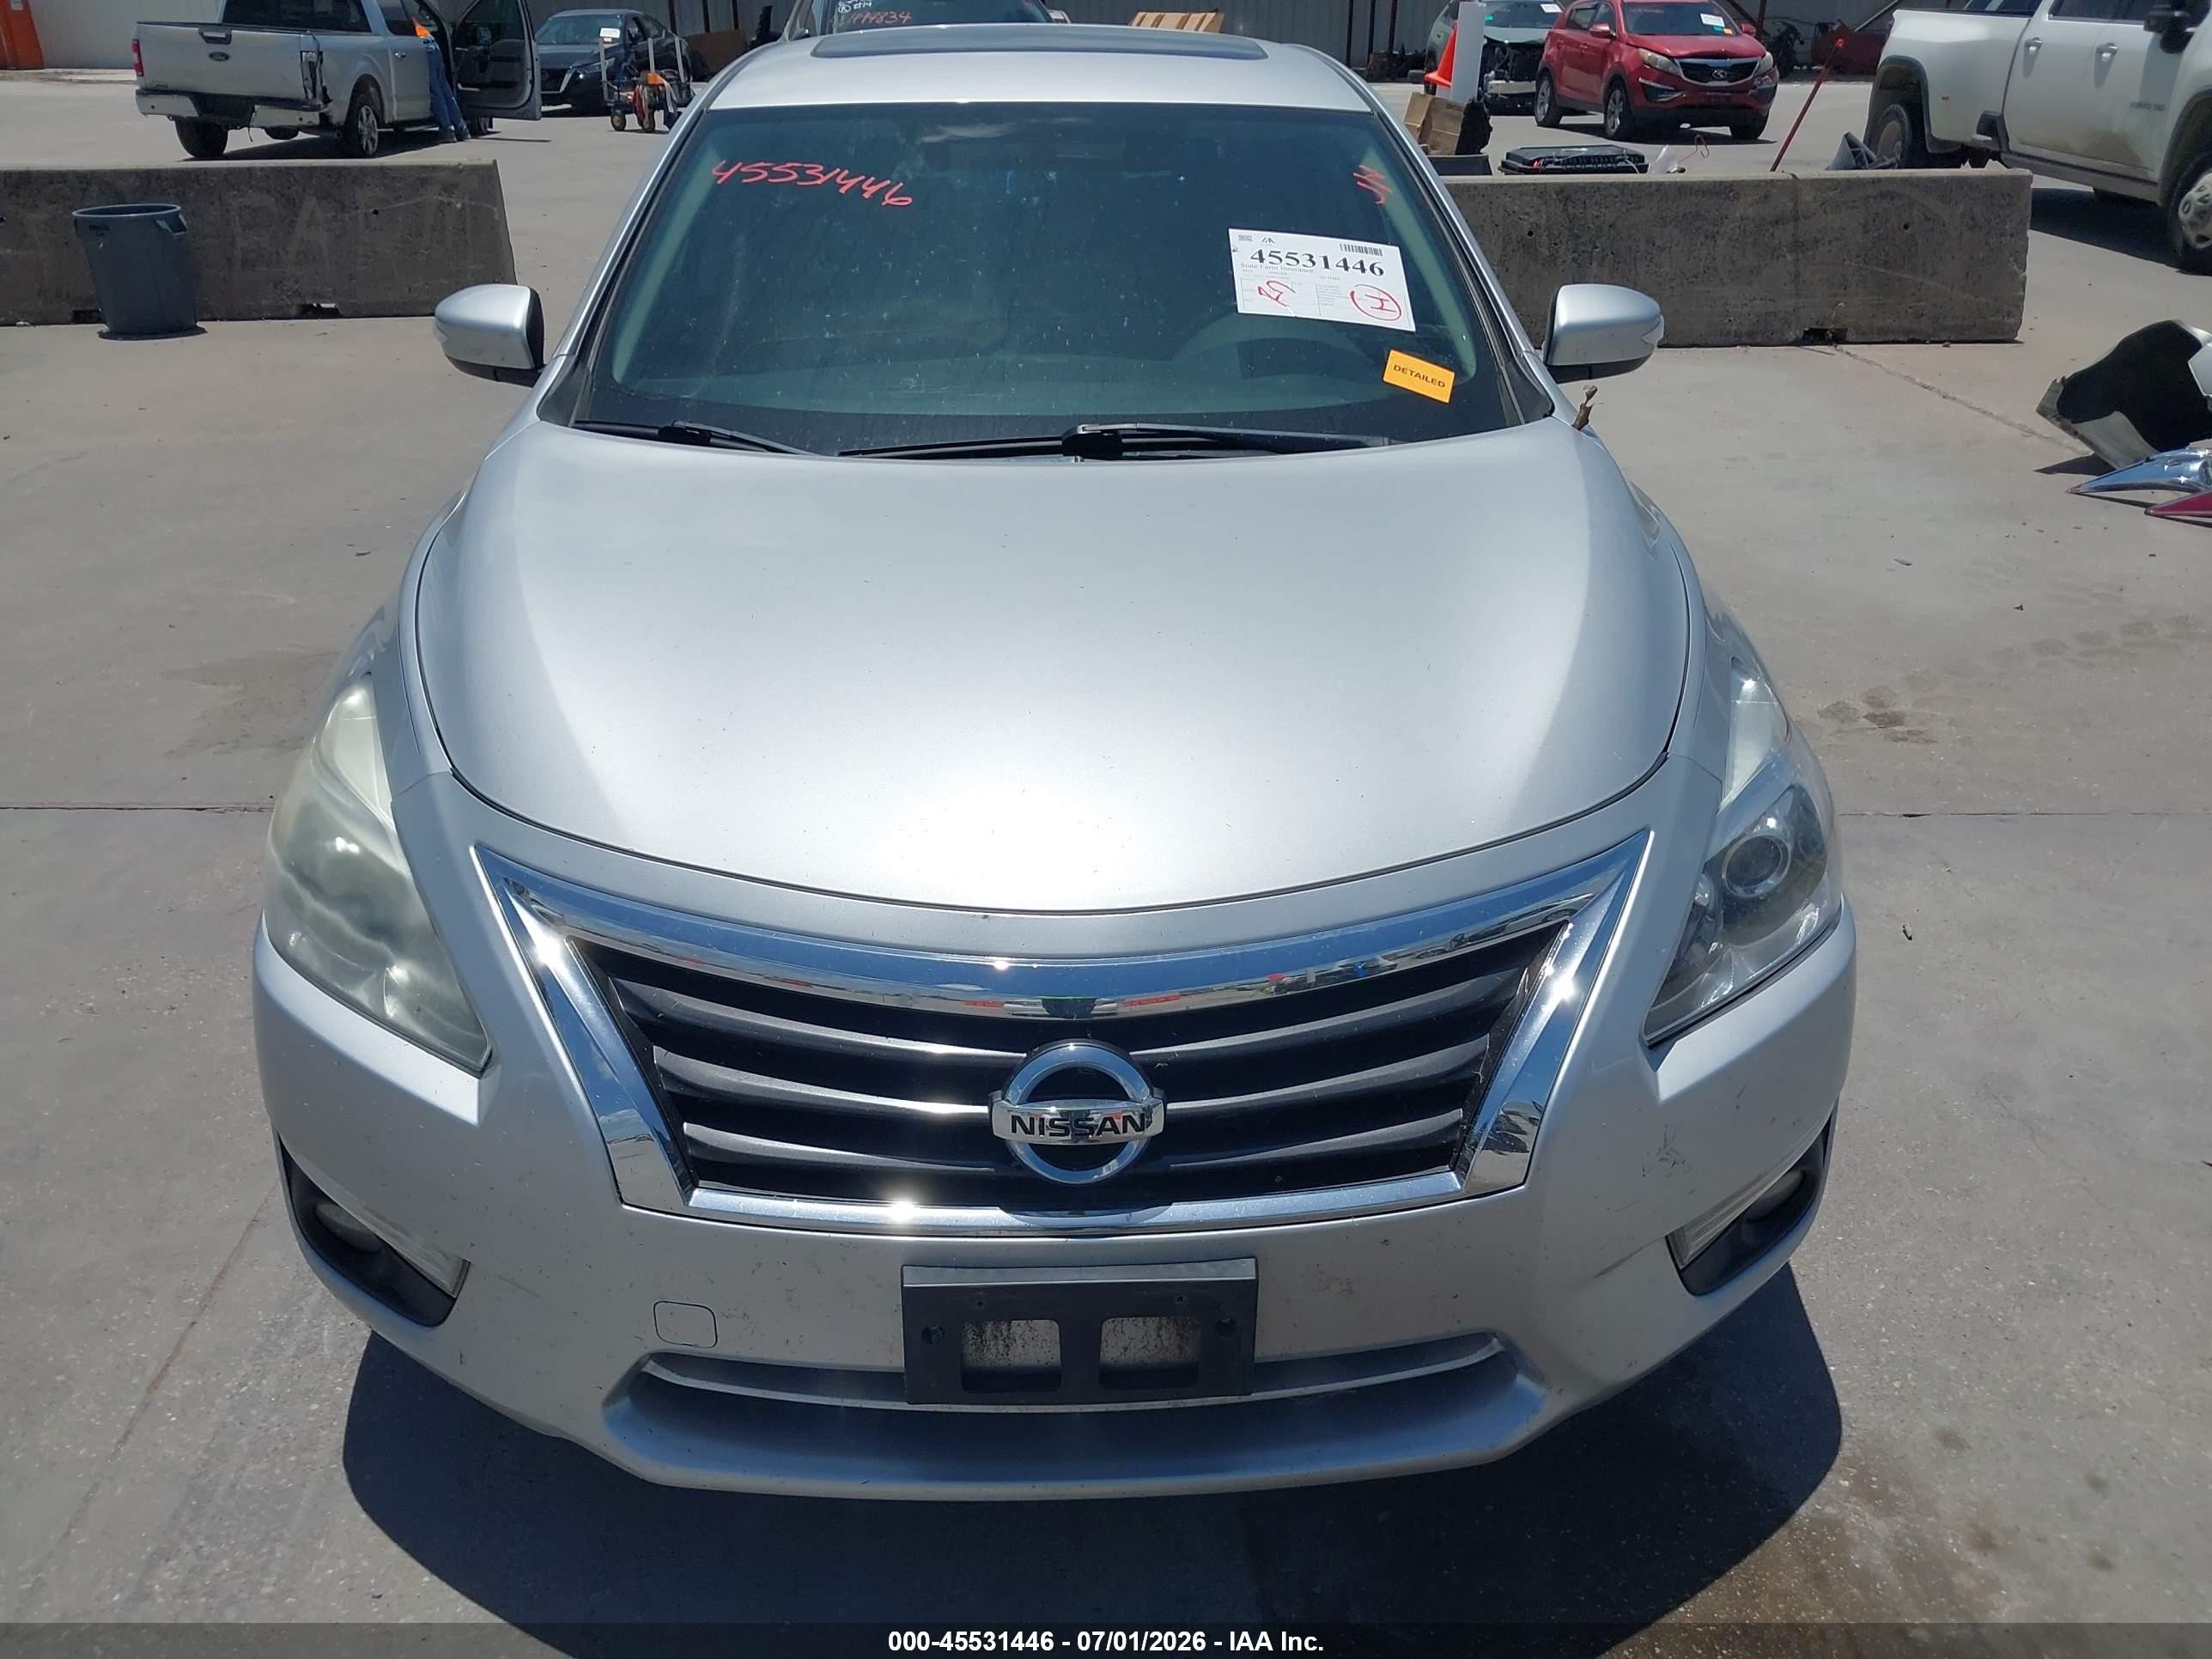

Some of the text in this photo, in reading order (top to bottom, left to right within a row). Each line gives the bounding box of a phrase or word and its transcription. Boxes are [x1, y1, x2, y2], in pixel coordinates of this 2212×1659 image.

[710, 160, 913, 207] 45531446
[1250, 248, 1385, 276] 45531446
[1393, 364, 1446, 388] DETAILED
[1011, 1113, 1146, 1137] NISSAN
